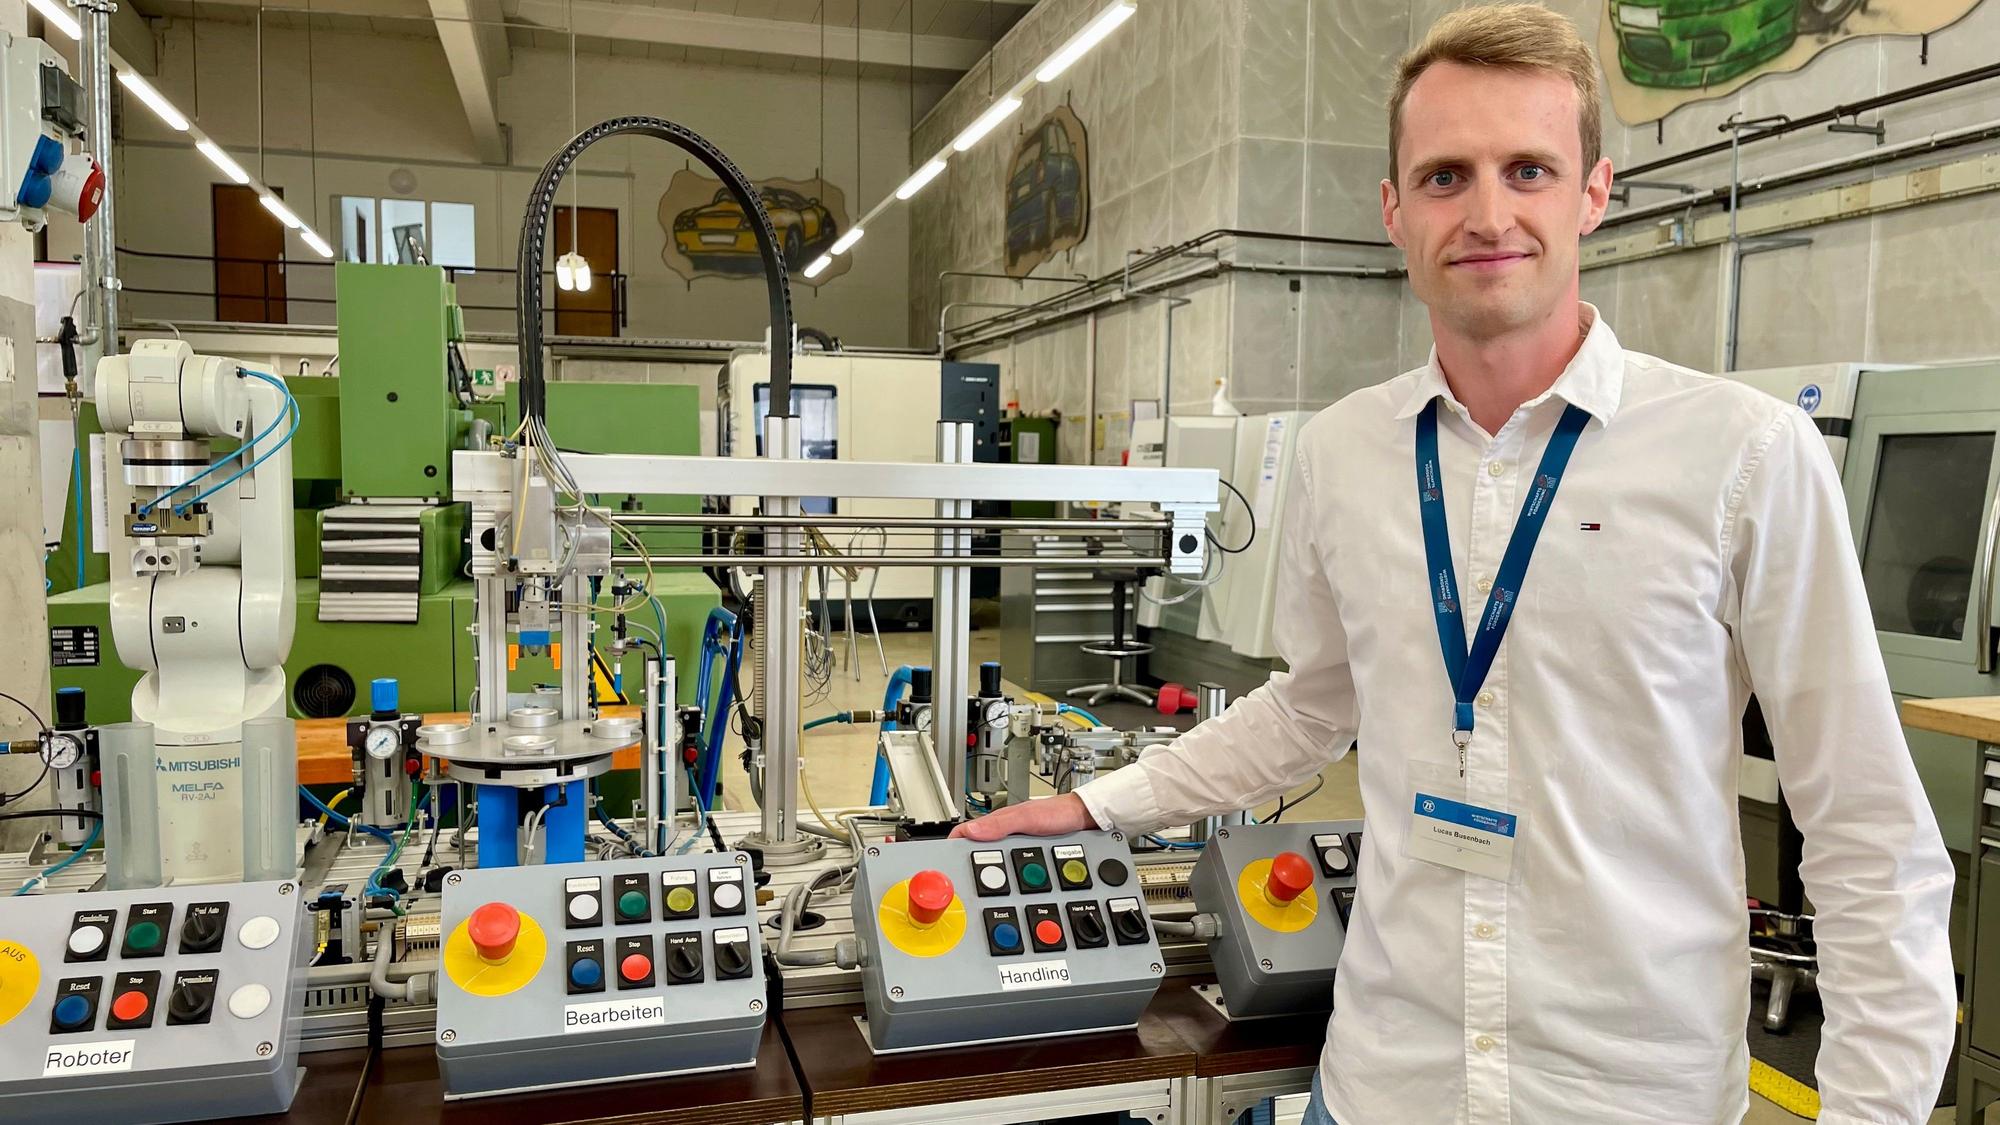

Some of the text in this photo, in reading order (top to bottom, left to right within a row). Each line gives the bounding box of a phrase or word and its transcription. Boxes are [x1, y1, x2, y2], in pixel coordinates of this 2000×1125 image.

[169, 757, 240, 772] MITSUBISHI
[172, 782, 224, 792] MELFA
[181, 792, 216, 801] RV-2AJ
[1433, 826, 1491, 846] Lucas Busenbach
[208, 906, 220, 914] Auto
[577, 945, 595, 953] Reset
[628, 941, 641, 949] Stop
[1000, 967, 1070, 985] Handling
[129, 977, 144, 985] Stop
[70, 982, 91, 991] Reset
[566, 1004, 664, 1027] Bearbeiten
[46, 1048, 132, 1069] Roboter
